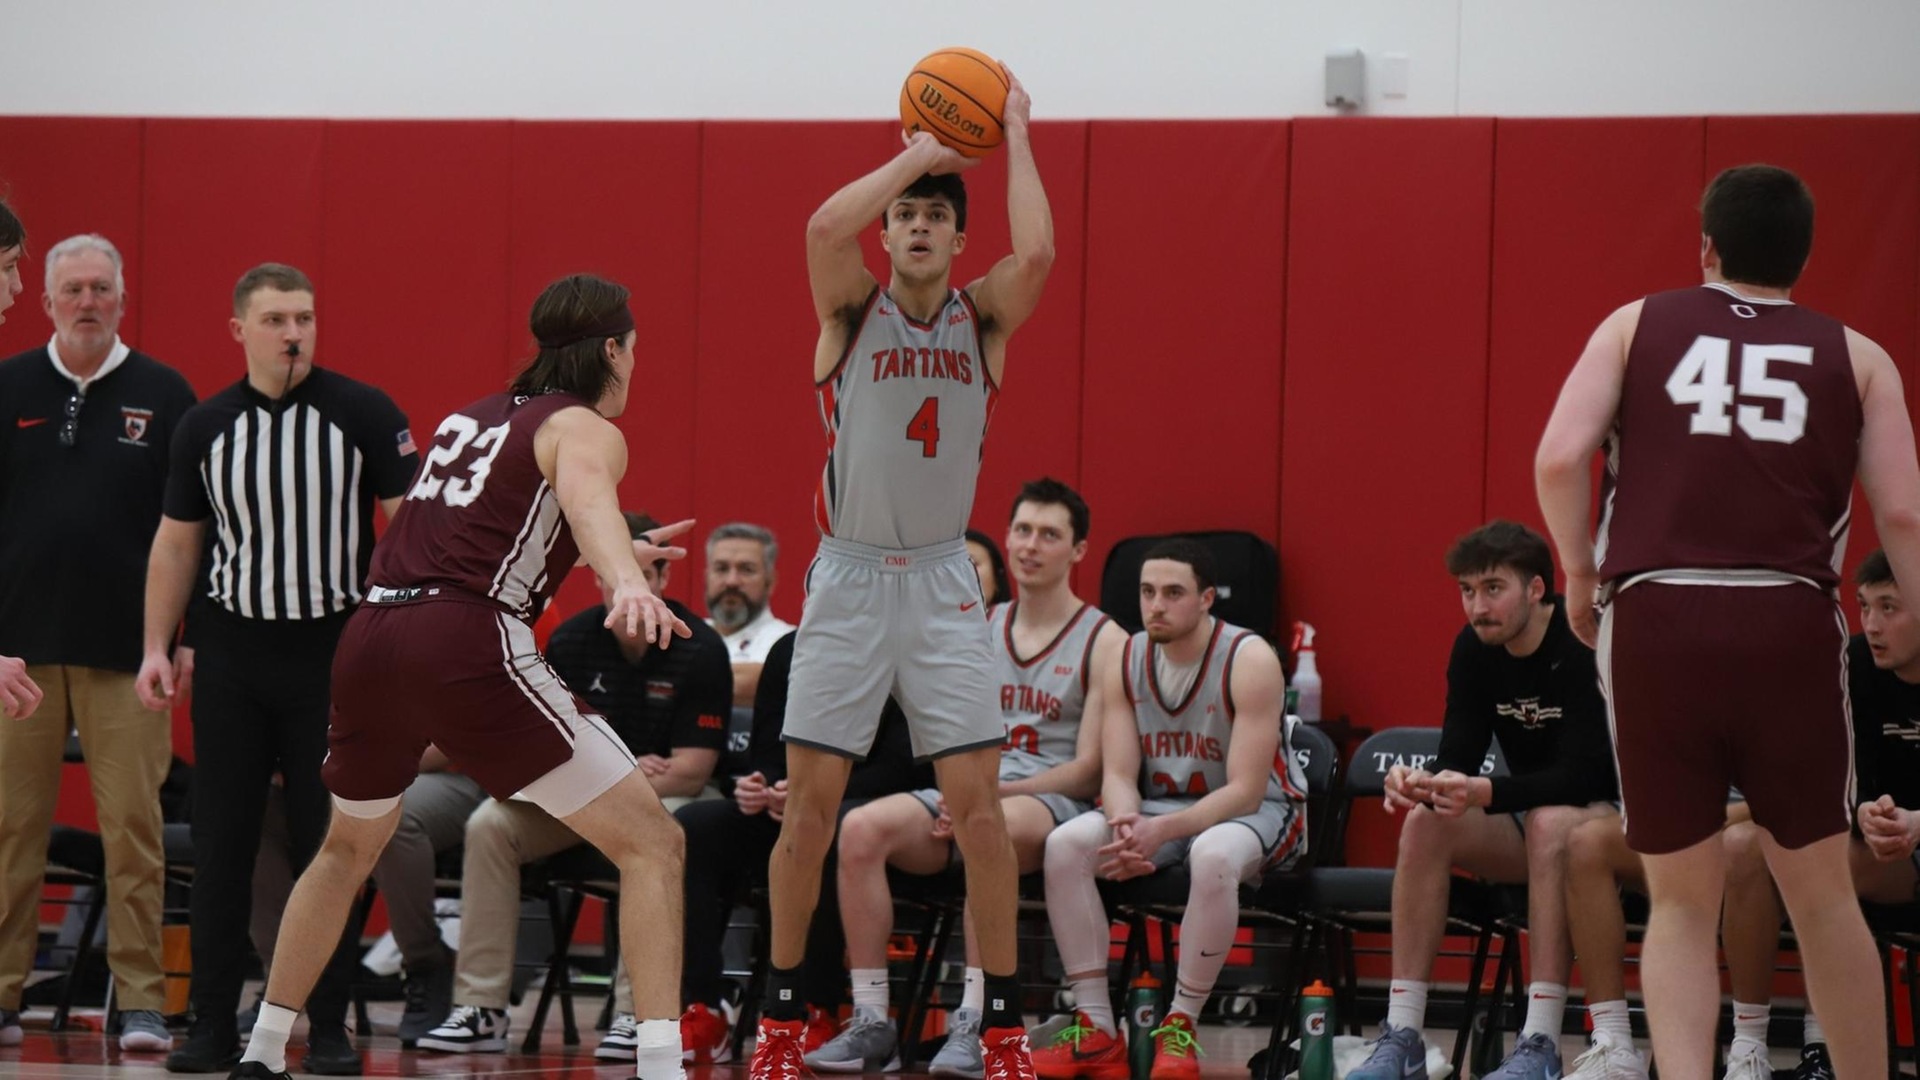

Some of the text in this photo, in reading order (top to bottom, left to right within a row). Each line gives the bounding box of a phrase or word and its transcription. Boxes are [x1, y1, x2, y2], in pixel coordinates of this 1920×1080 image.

[920, 83, 985, 139] Wilson
[871, 347, 973, 385] TARTANS
[1665, 334, 1814, 444] 45
[906, 396, 940, 458] 4
[406, 413, 510, 507] 23
[885, 556, 909, 567] CMU
[1001, 684, 1062, 721] RTANS
